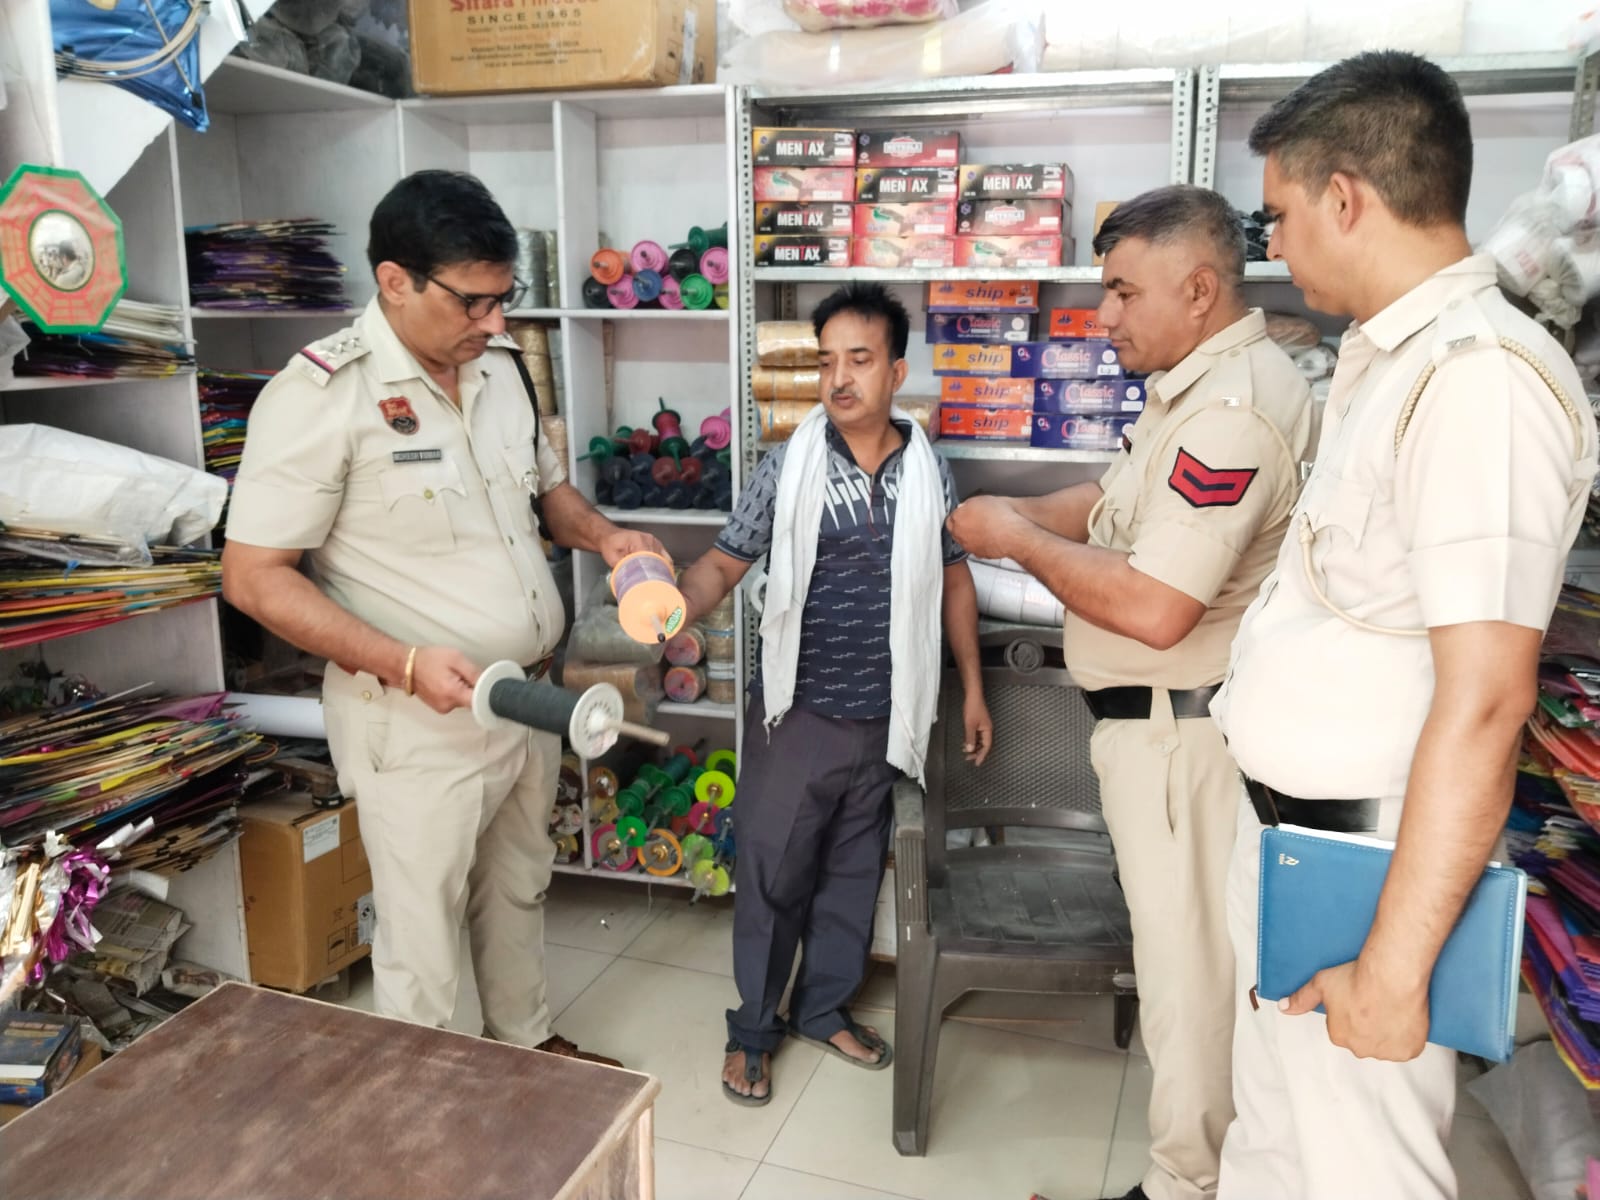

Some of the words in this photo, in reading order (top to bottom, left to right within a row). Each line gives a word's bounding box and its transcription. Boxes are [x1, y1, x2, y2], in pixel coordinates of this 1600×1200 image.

[467, 12, 526, 25] SINCE
[535, 9, 581, 21] 1965
[776, 139, 825, 156] MENTAX
[880, 176, 928, 193] MENTAX
[983, 173, 1033, 190] MENTAX
[777, 210, 824, 226] MENTAX
[774, 245, 820, 261] MENTAX
[966, 286, 1004, 301] ship
[956, 315, 1002, 334] Classic
[968, 351, 1004, 366] ship
[1041, 348, 1092, 368] Classic
[974, 385, 1010, 399] ship
[1064, 383, 1115, 405] Classic
[973, 416, 1009, 431] ship
